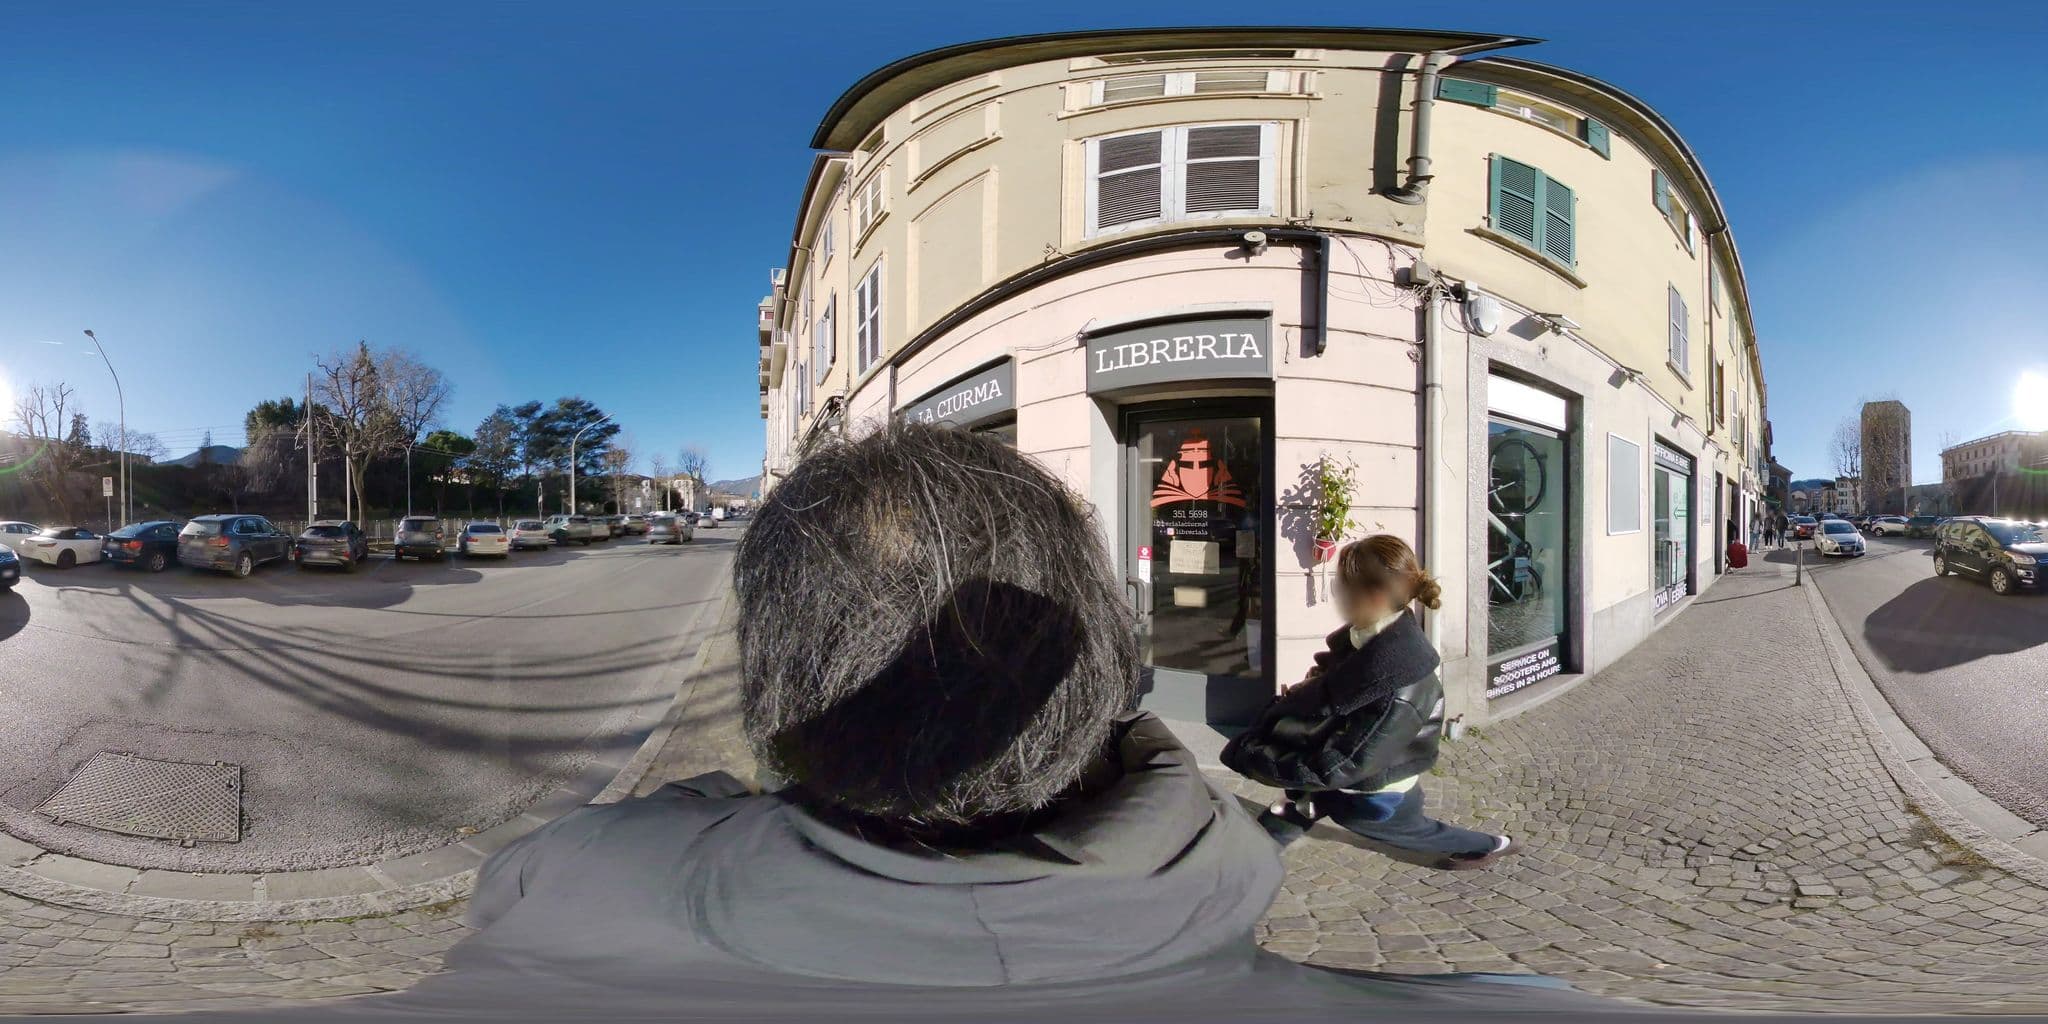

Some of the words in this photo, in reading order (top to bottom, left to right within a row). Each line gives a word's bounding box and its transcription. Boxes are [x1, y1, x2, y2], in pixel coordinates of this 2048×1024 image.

[1095, 333, 1263, 373] LIBRERIA
[918, 408, 934, 424] LA
[937, 379, 1003, 418] CIURMA
[1172, 510, 1186, 518] 351
[1188, 510, 1208, 518] 5698
[1500, 655, 1537, 673] SERVICE
[1537, 649, 1549, 660] ON
[1541, 656, 1557, 669] AND
[1516, 678, 1525, 689] IN
[1526, 675, 1536, 685] 24
[1536, 664, 1562, 680] HOURS
